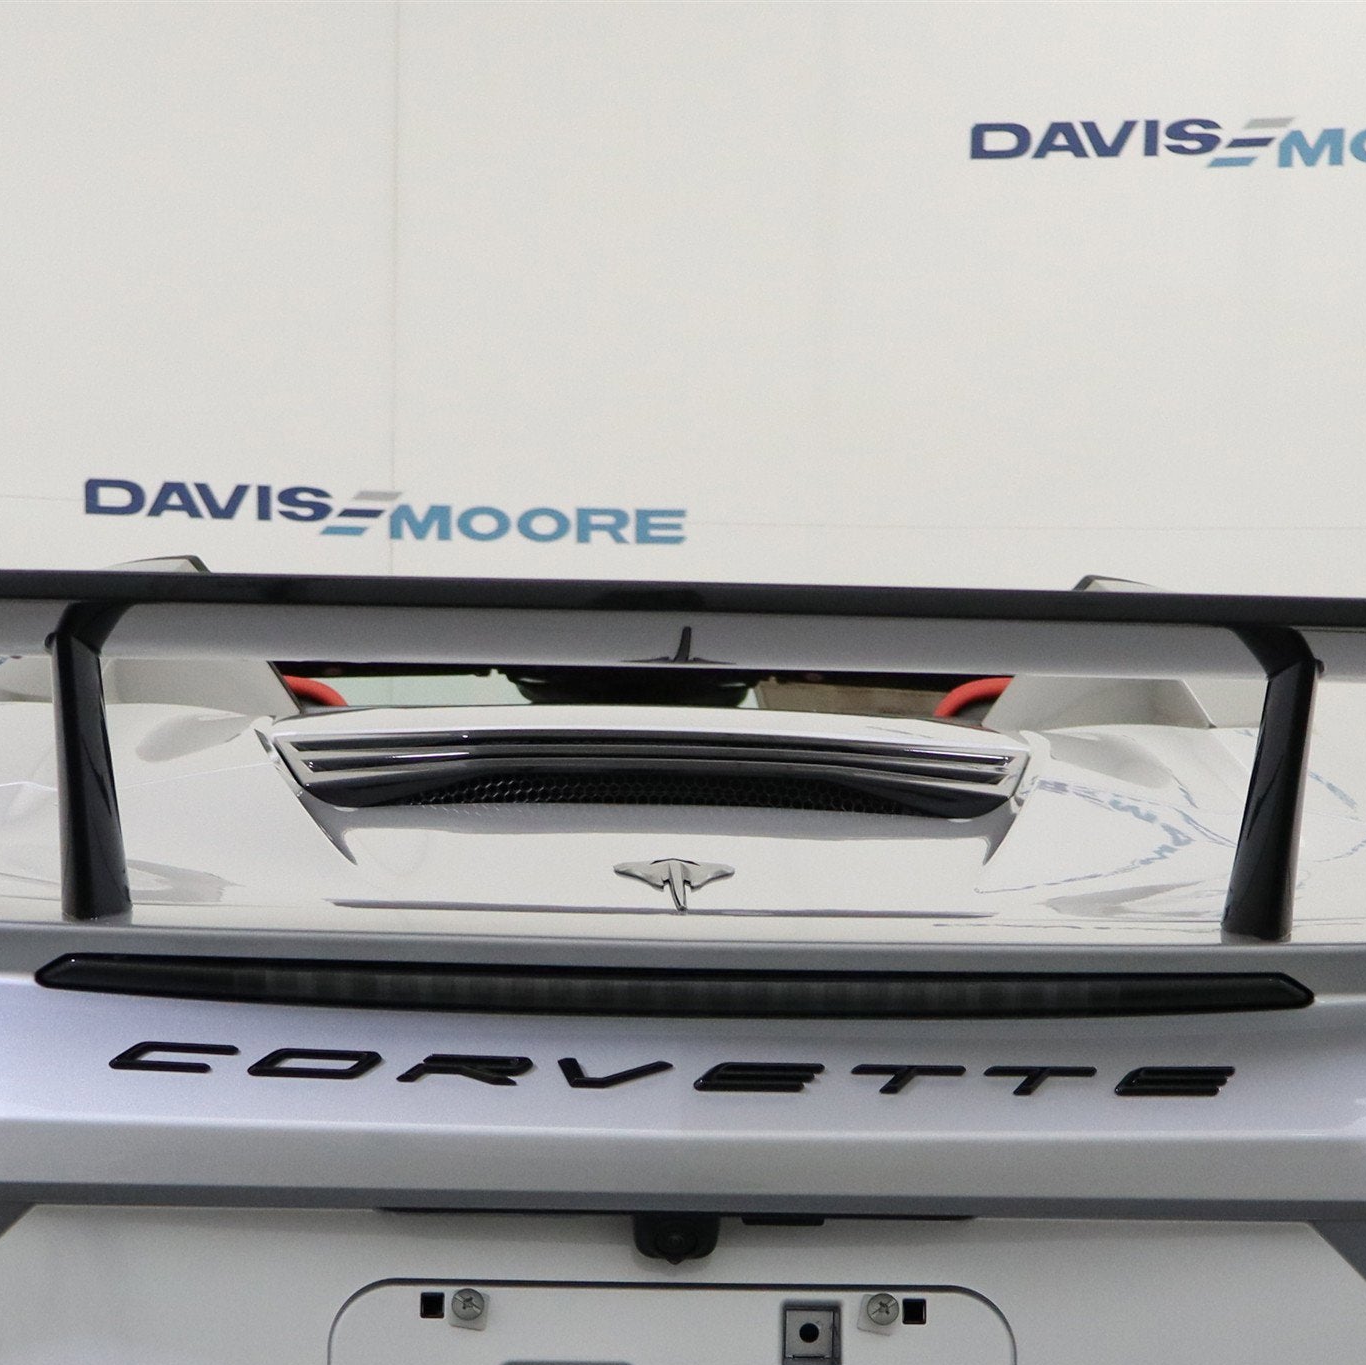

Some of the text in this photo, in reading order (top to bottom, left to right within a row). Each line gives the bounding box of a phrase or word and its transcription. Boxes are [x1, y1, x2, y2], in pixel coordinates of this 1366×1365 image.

[969, 118, 1222, 160] DAVIS
[83, 477, 686, 545] DAVIS MOORE
[108, 1041, 1236, 1098] CORVETTE
